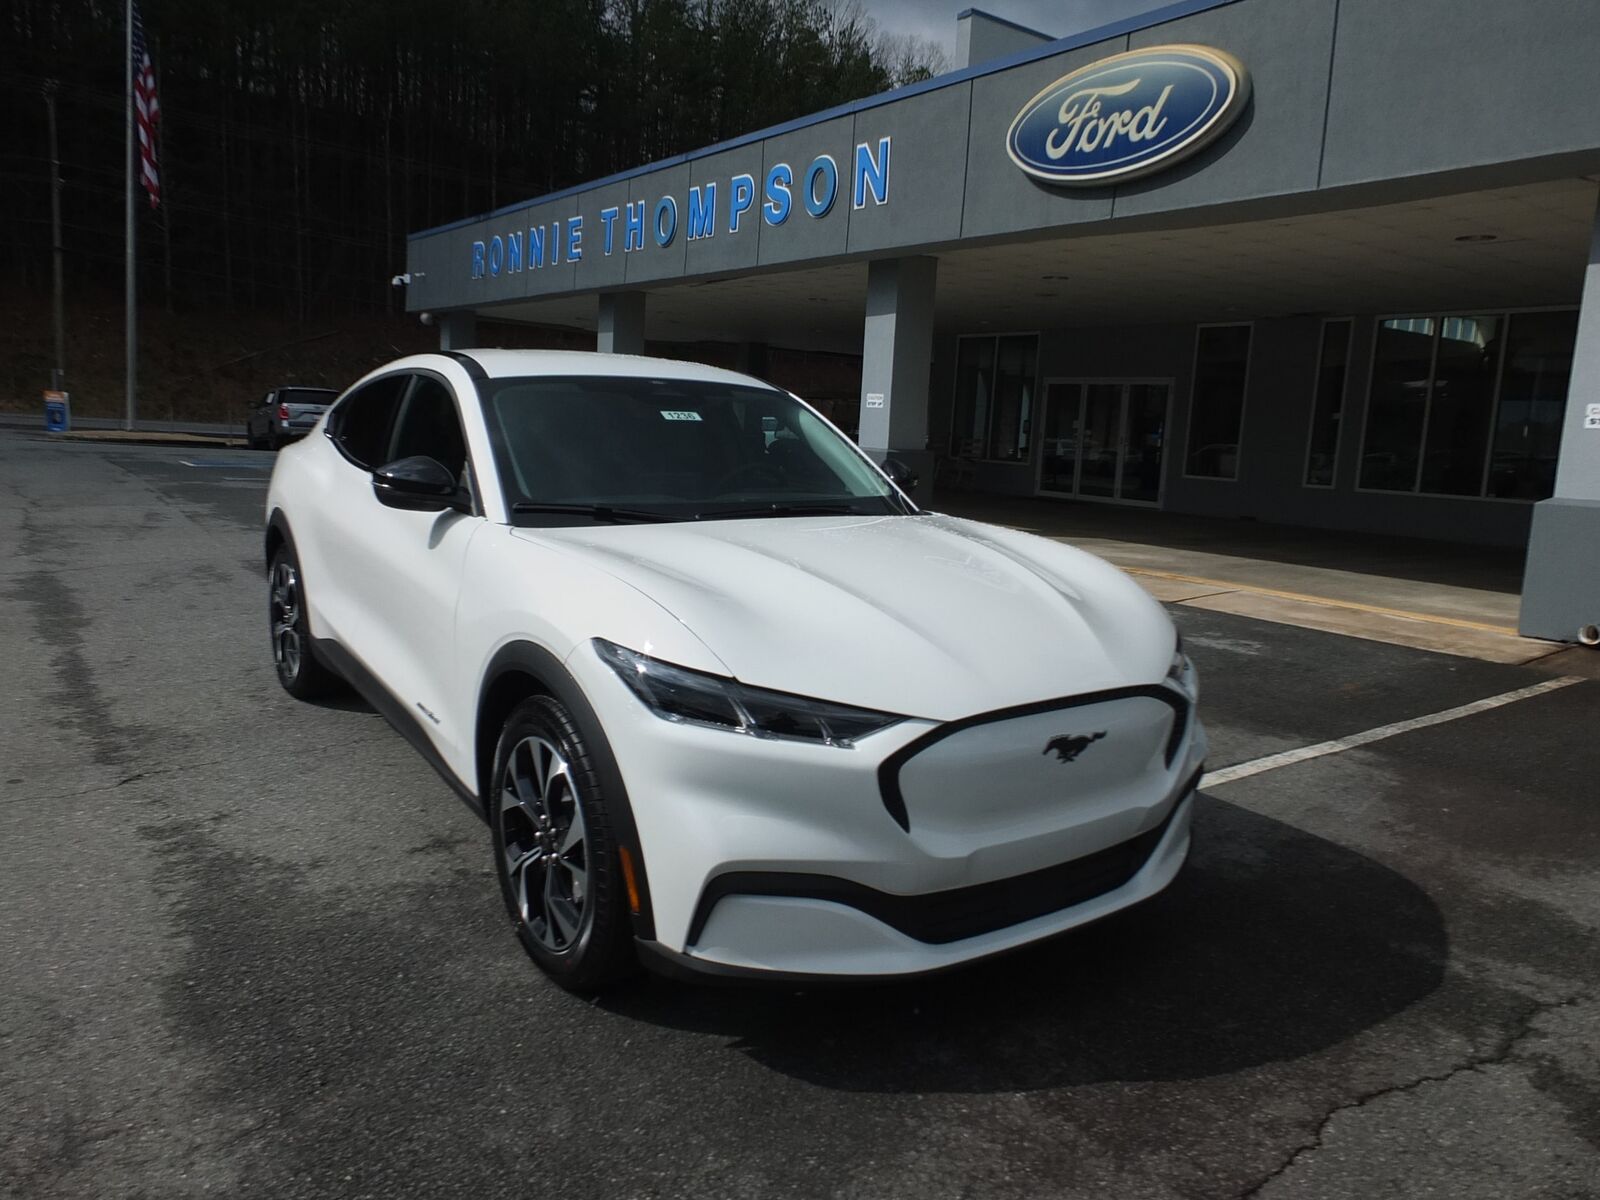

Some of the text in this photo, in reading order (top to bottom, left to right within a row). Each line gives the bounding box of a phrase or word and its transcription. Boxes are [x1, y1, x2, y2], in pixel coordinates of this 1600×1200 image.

[1045, 78, 1175, 160] Ford
[471, 135, 892, 280] RONNIE THOMPSON
[667, 412, 697, 420] 1236
